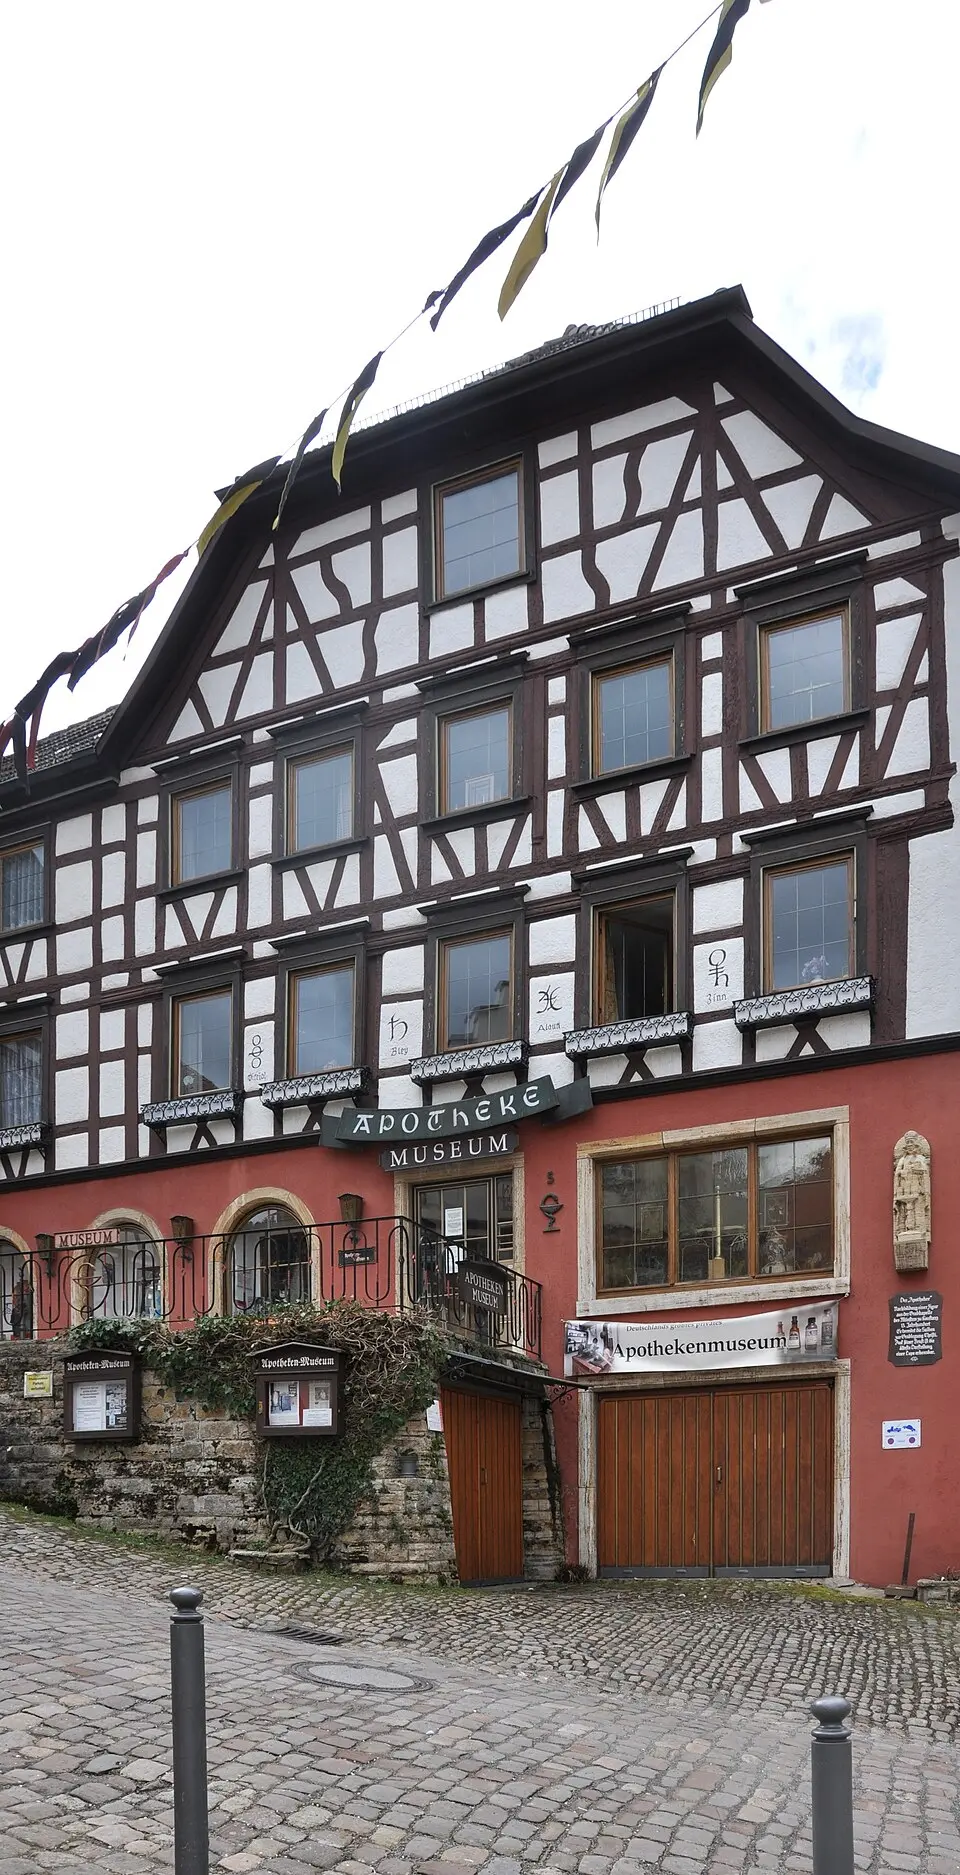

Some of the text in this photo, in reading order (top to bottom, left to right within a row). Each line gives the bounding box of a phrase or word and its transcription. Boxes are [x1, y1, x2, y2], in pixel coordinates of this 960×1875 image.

[389, 1133, 509, 1168] MUSEUM
[59, 1231, 113, 1247] MUSEUM
[464, 1271, 504, 1296] APOTHEKEN
[472, 1288, 499, 1309] MUSEUM
[626, 1324, 669, 1332] Deutschlands
[613, 1335, 787, 1361] Apothekenmuseum
[67, 1359, 130, 1371] Apotheken-Museum
[261, 1356, 335, 1369] Apotheken-Museum
